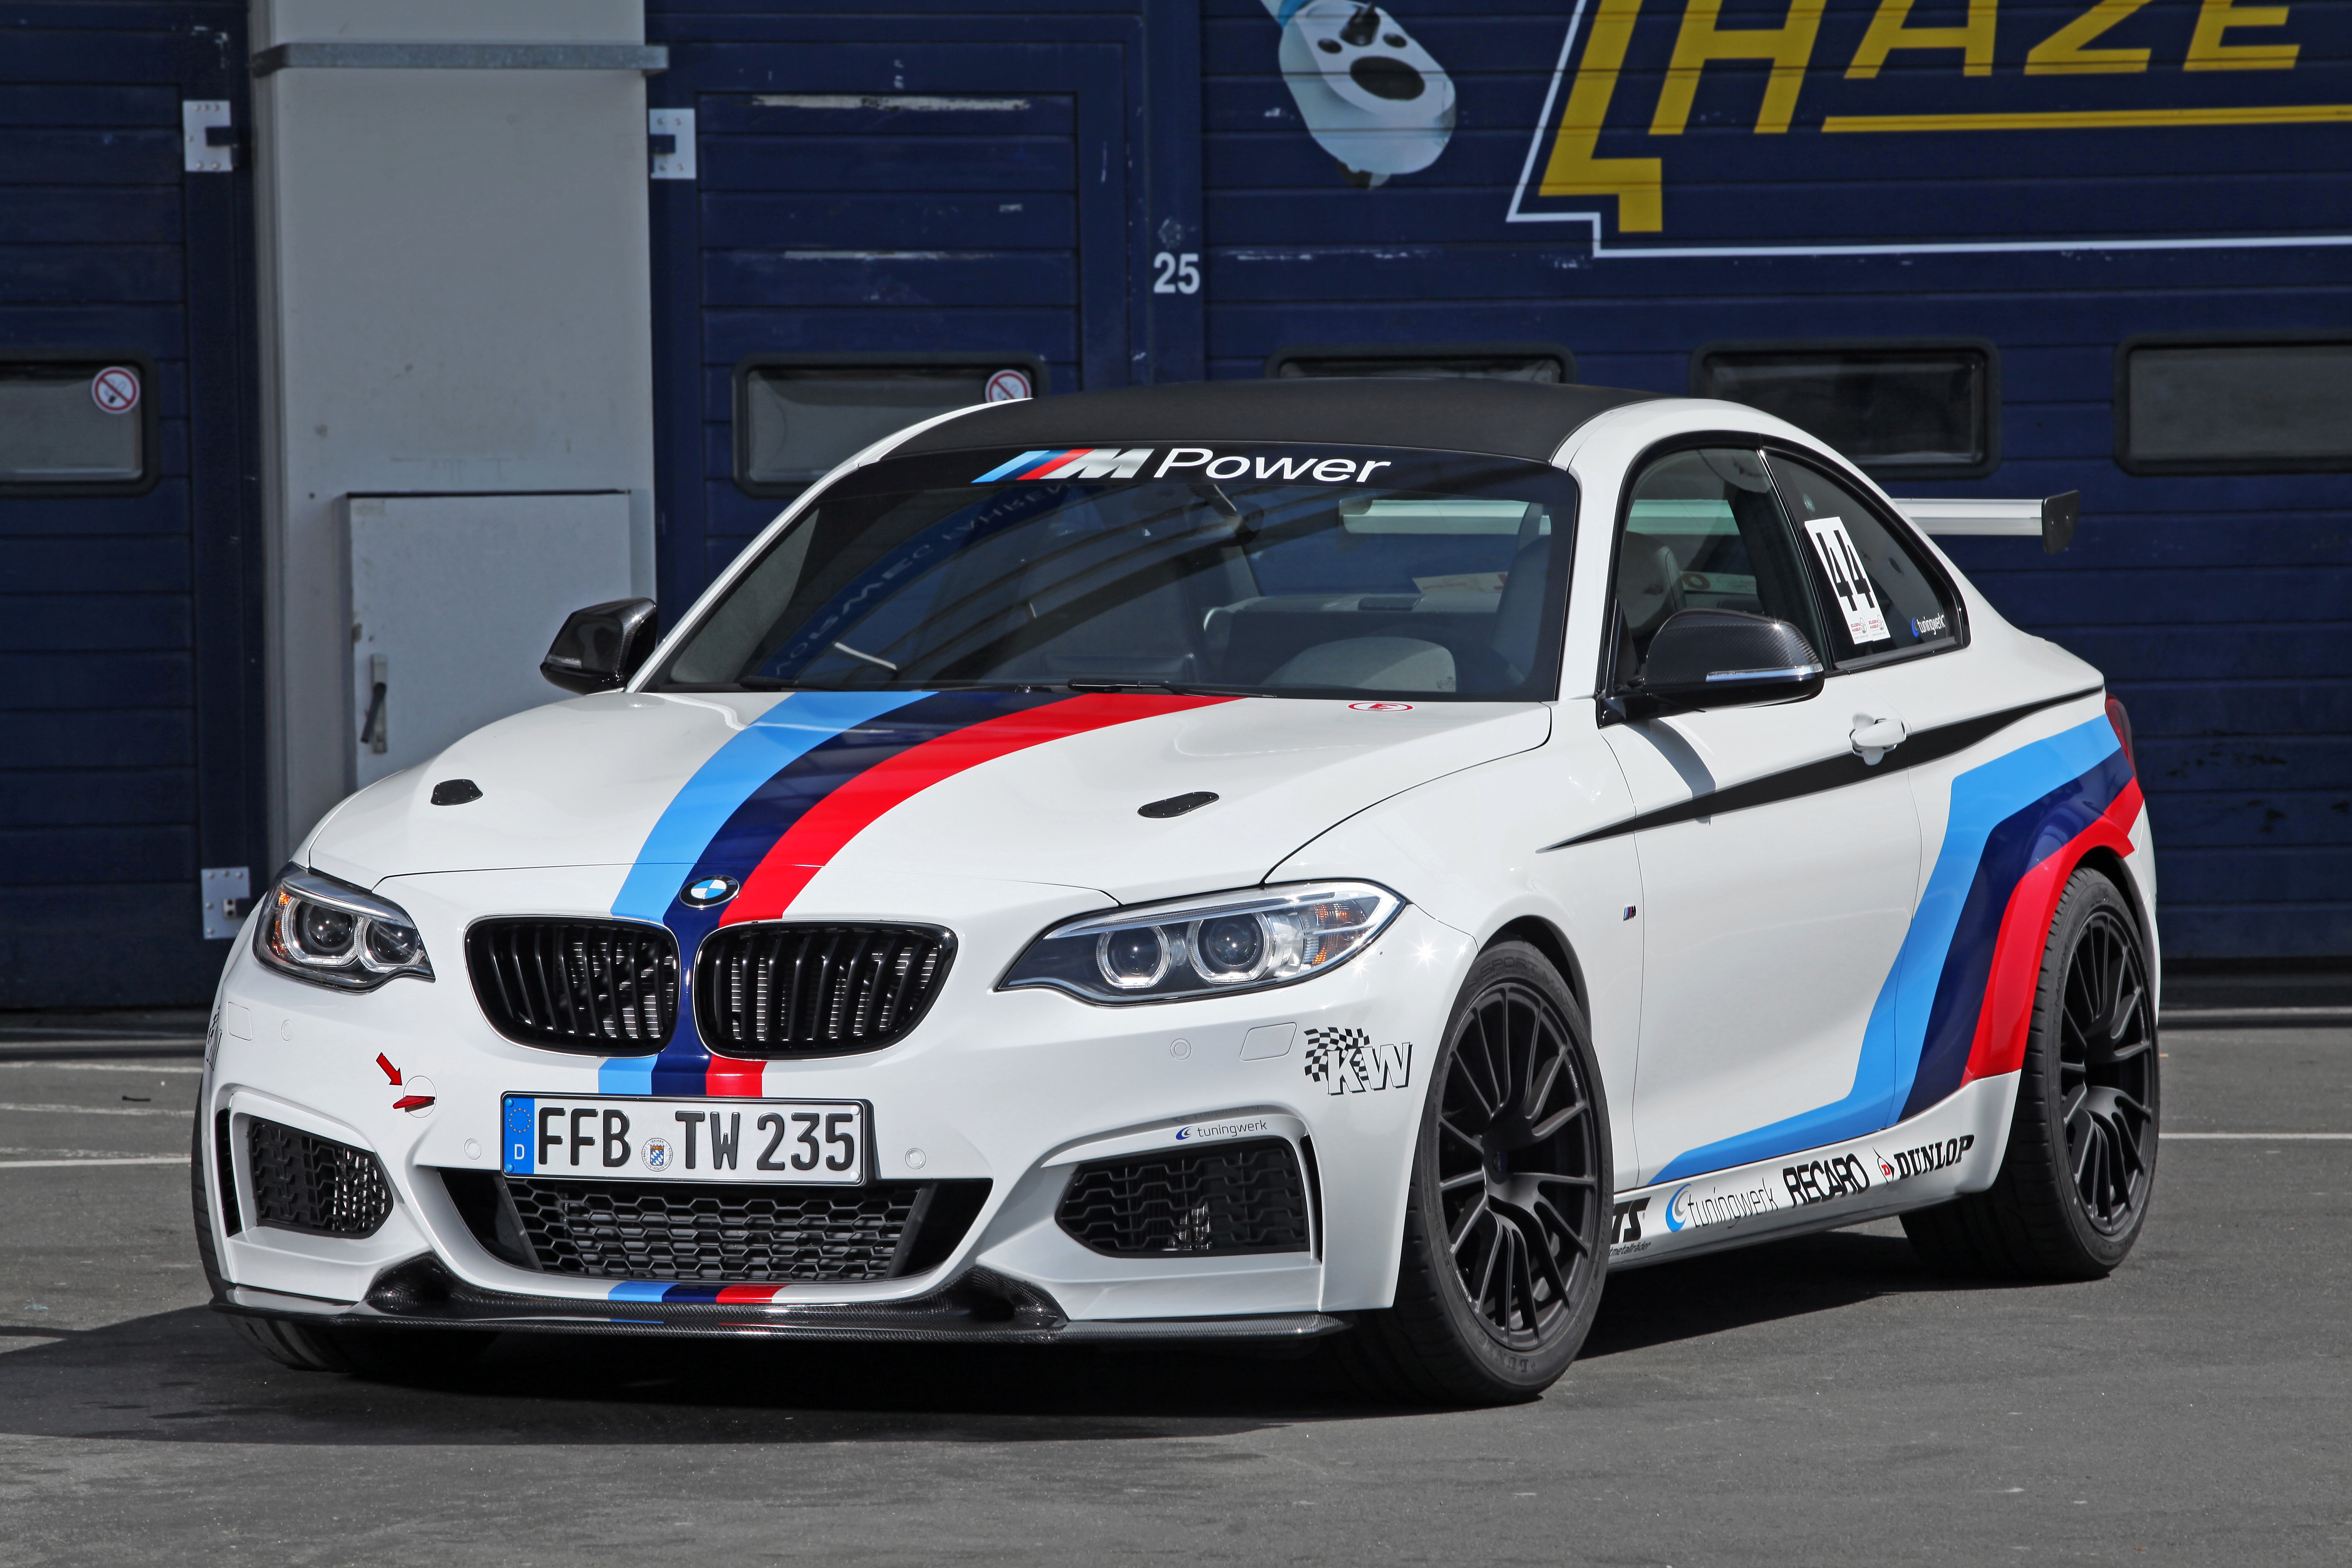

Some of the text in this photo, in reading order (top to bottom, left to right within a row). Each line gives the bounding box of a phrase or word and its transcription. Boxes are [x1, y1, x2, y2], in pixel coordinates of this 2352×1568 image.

[1153, 251, 1200, 294] 25
[1153, 448, 1391, 482] Power
[1815, 529, 1875, 611] 44
[1916, 613, 1945, 635] tuningwerk
[1480, 956, 1539, 977] SPORT
[1326, 1042, 1413, 1096] KW
[539, 1107, 631, 1168] FFB
[675, 1110, 741, 1170] TW
[756, 1112, 855, 1171] 235
[1197, 1120, 1267, 1137] tuningwerk
[513, 1144, 525, 1161] D
[1893, 1135, 1975, 1179] DUNLOP
[1782, 1153, 1870, 1208] RECARO
[1612, 1197, 1651, 1245] TS
[1687, 1178, 1779, 1228] tuningwerk
